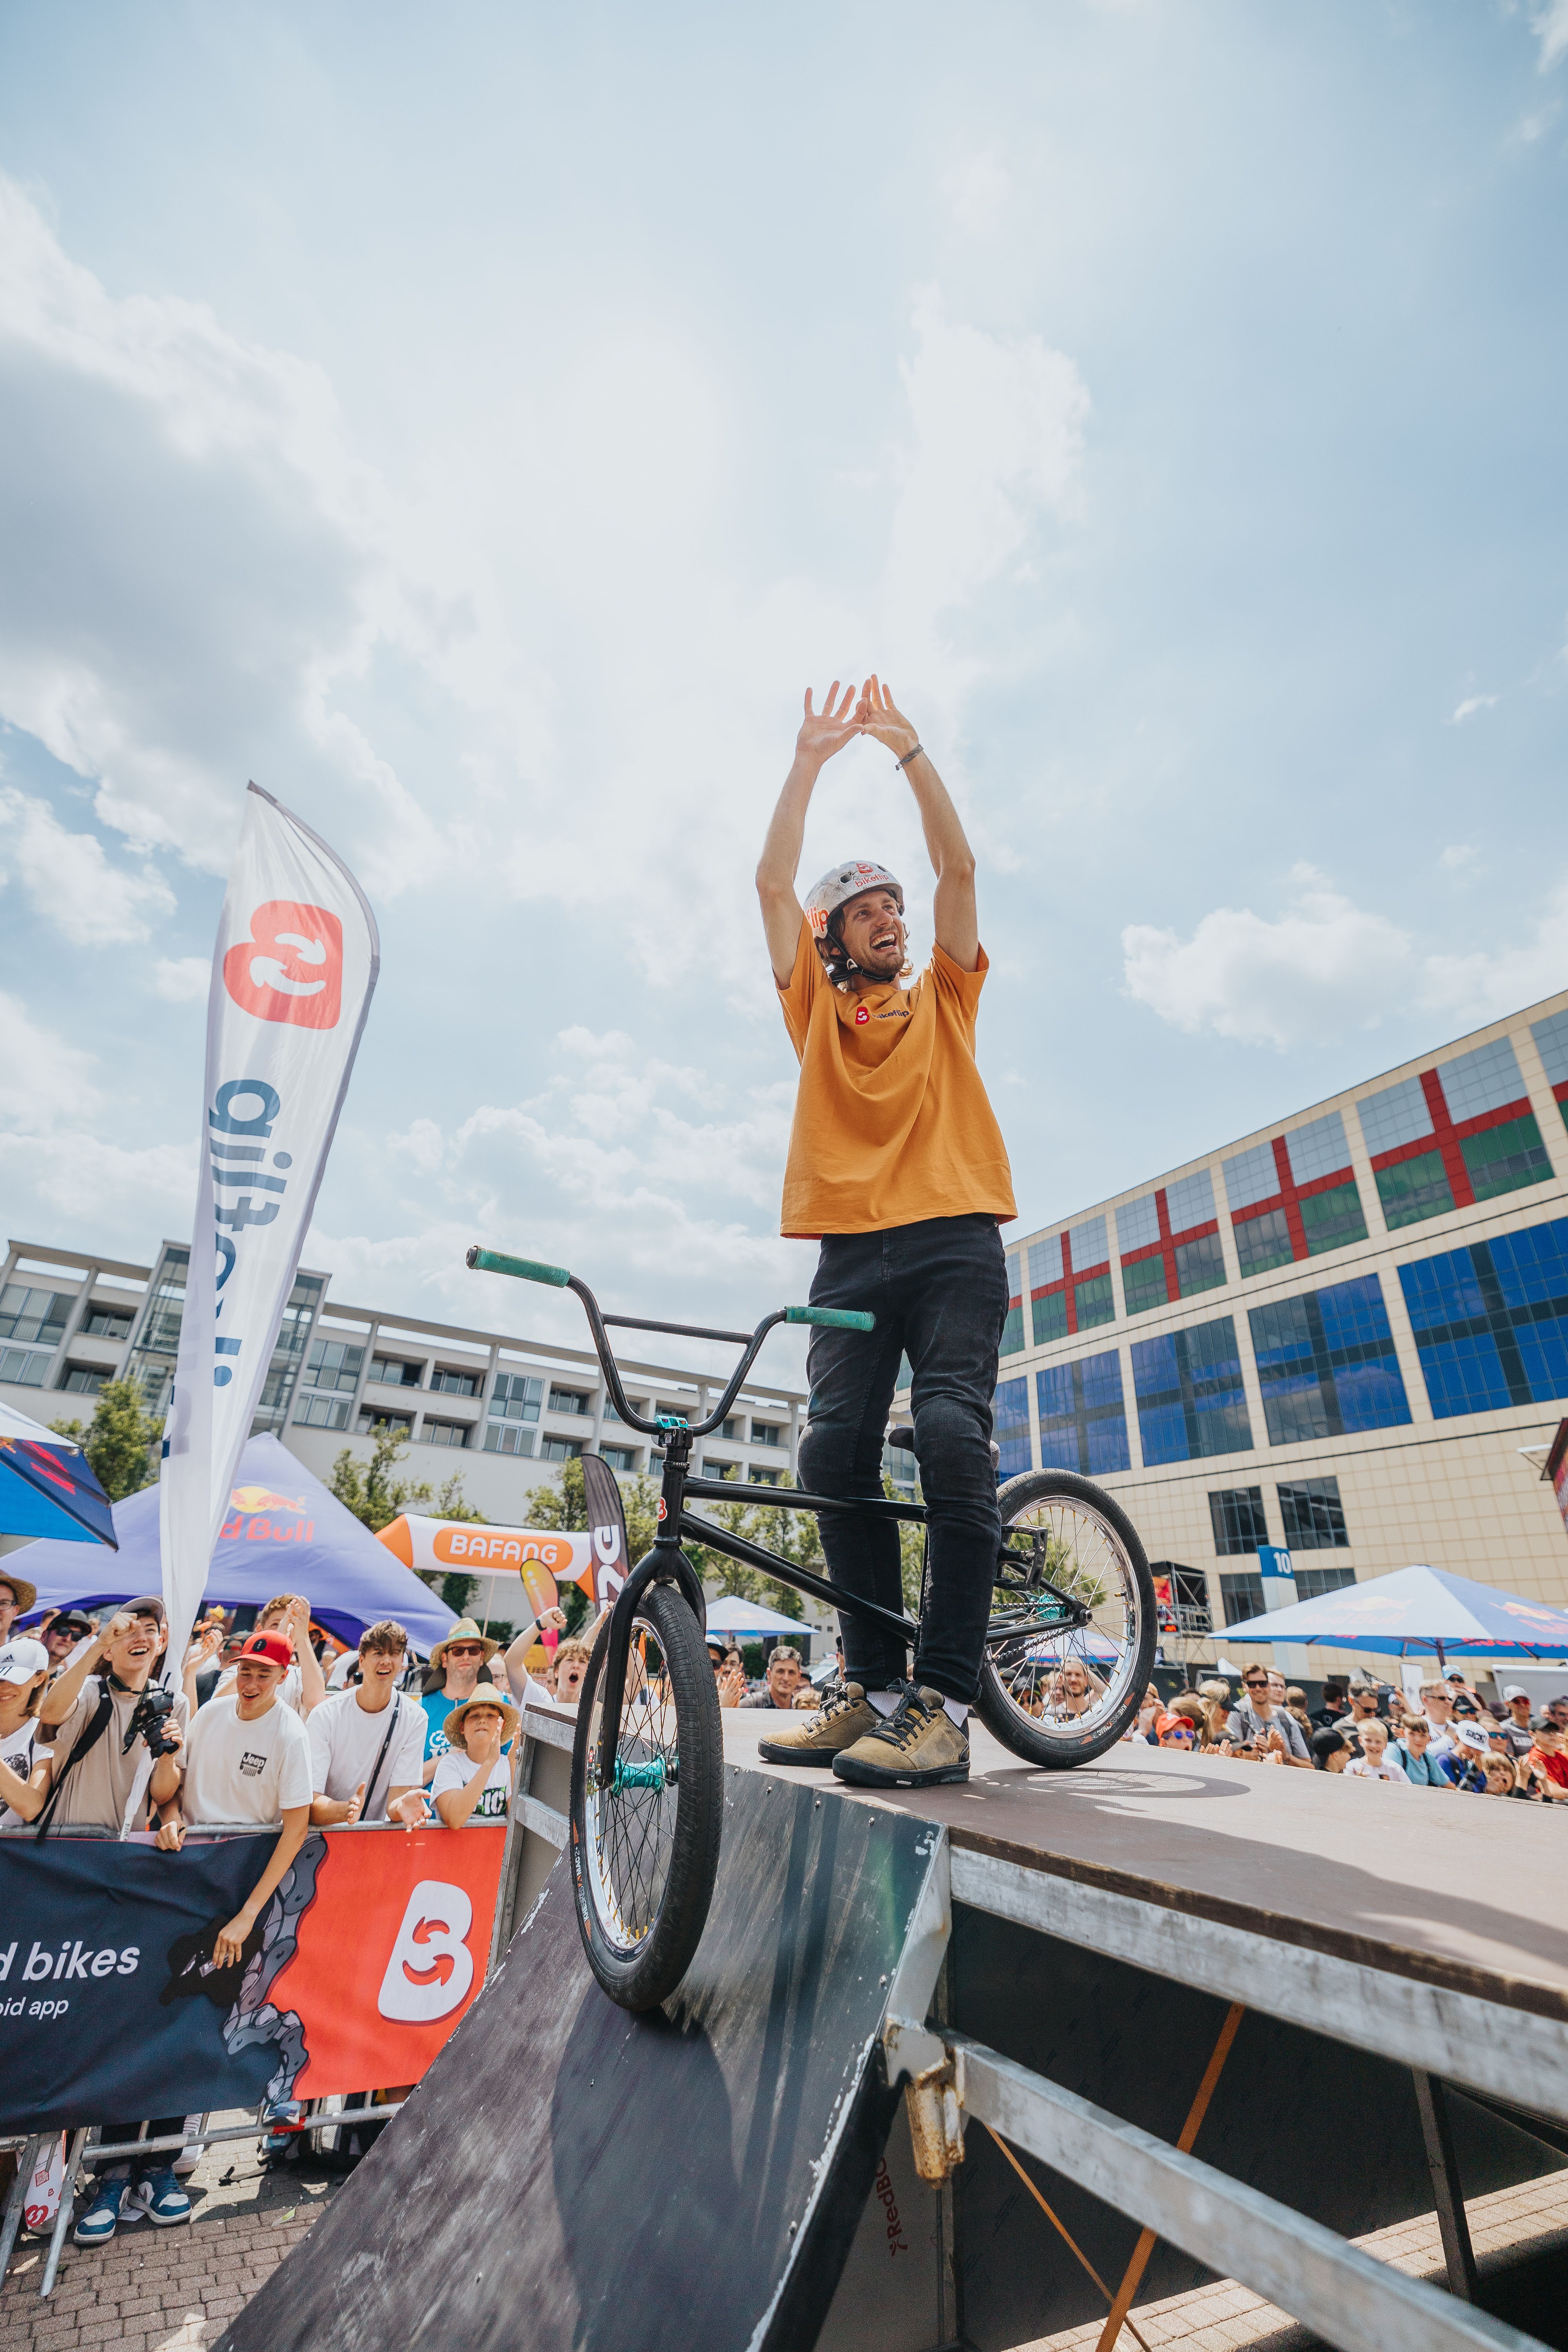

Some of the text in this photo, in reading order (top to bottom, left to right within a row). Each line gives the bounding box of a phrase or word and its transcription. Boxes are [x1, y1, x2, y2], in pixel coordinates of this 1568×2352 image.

[855, 873, 889, 887] bikeflip
[246, 1518, 315, 1542] Bull
[449, 1534, 558, 1565] BAFANG
[1273, 1552, 1292, 1574] 10
[243, 1753, 265, 1768] Jeep
[22, 1941, 140, 1980] bikes
[29, 2000, 69, 2020] app
